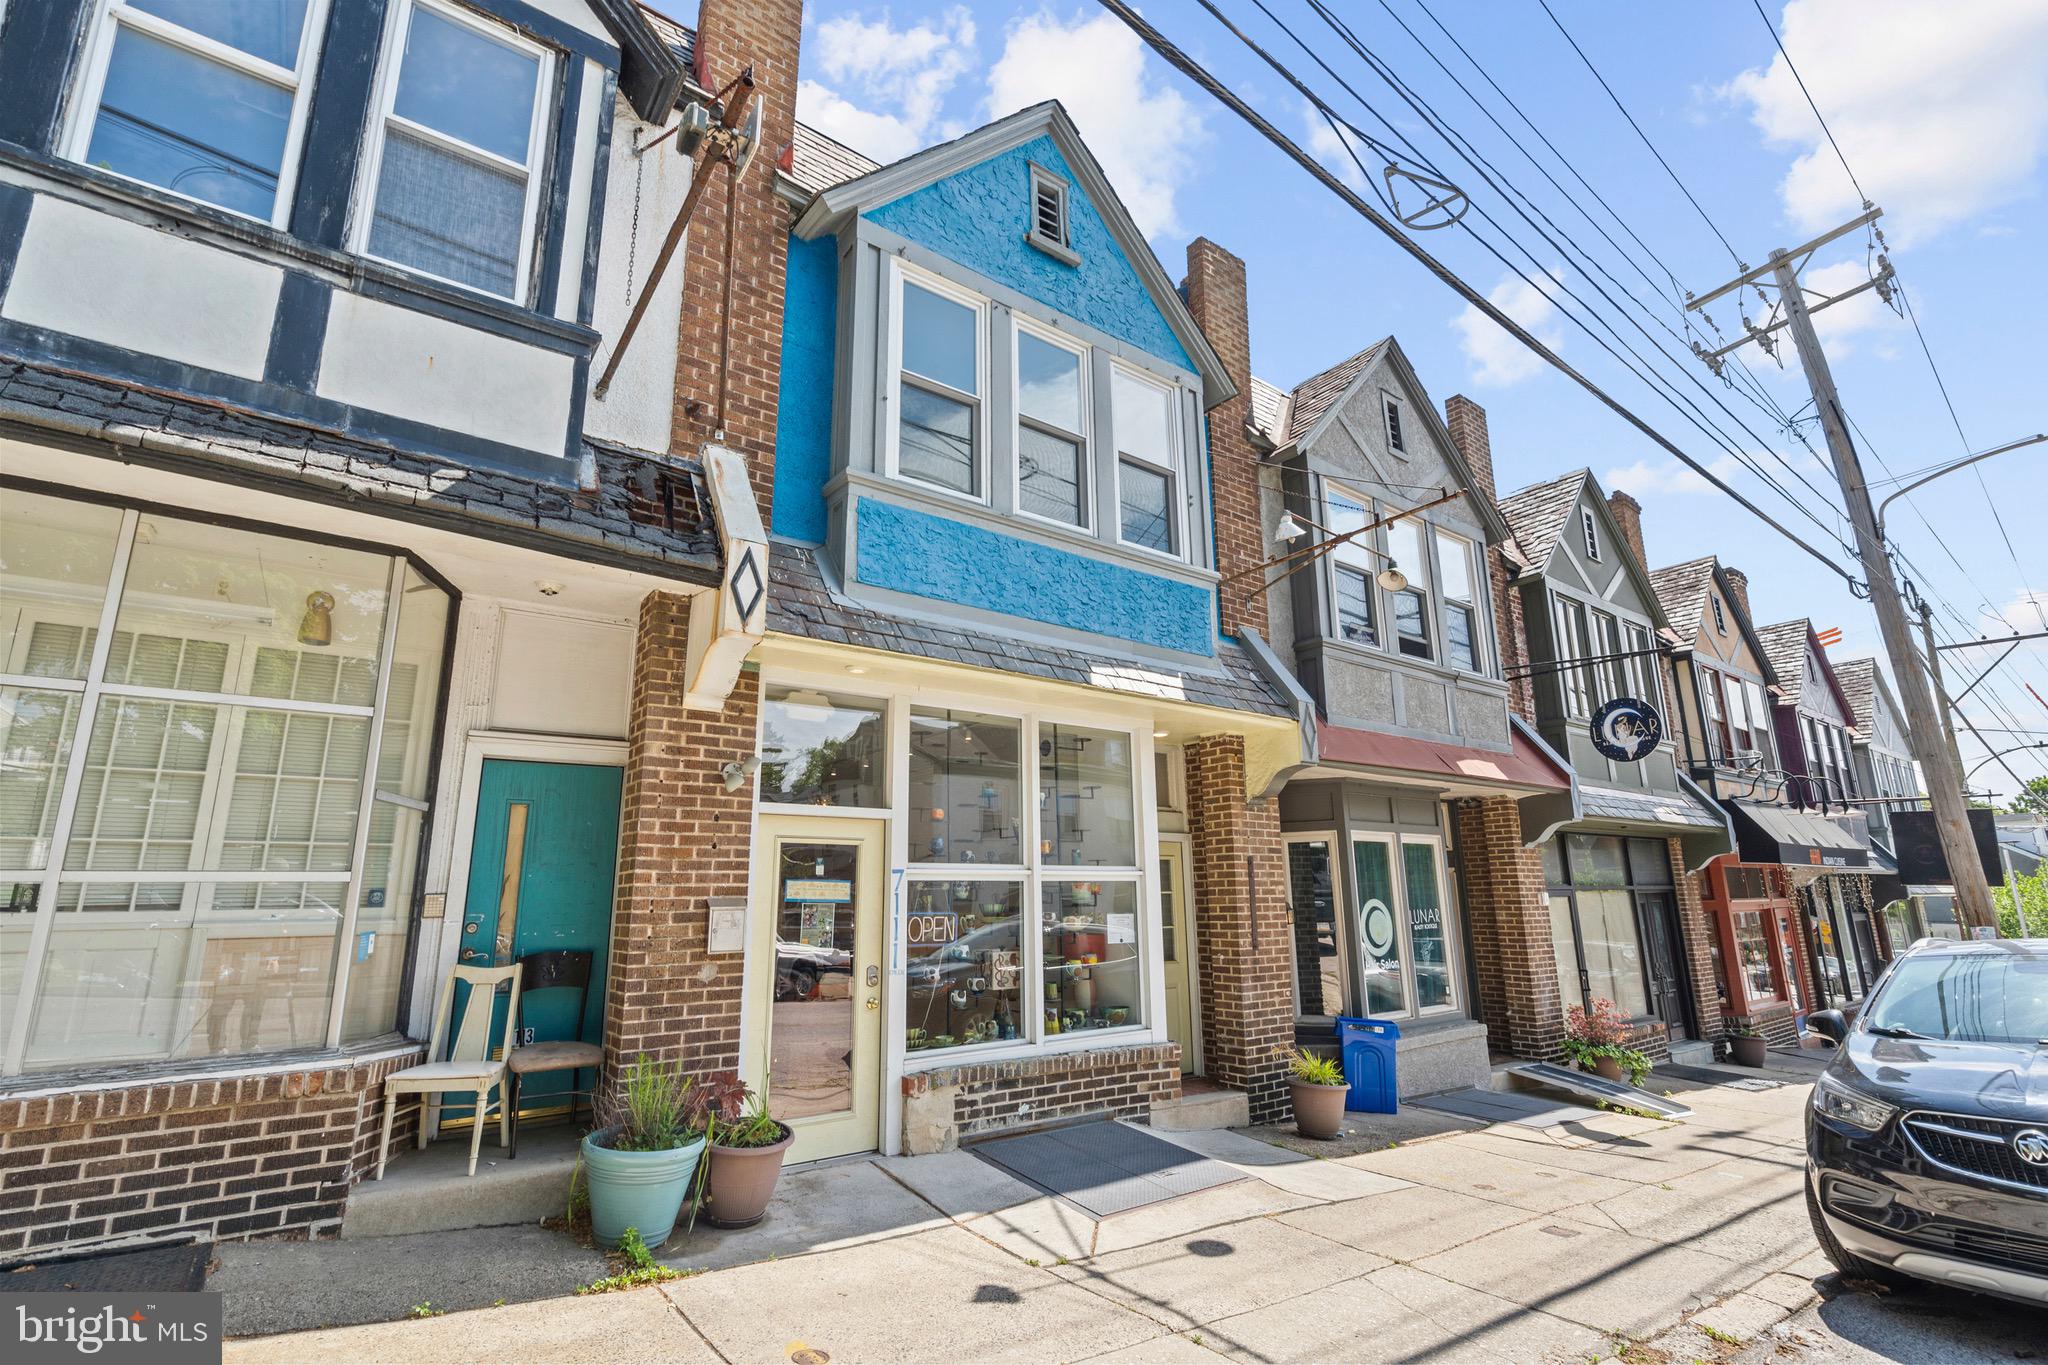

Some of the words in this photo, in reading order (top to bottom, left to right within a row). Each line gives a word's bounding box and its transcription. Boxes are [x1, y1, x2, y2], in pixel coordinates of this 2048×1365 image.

[892, 869, 905, 969] 7111
[1409, 908, 1441, 925] LUNAR
[908, 916, 955, 942] OPEN
[1380, 958, 1400, 970] Salon
